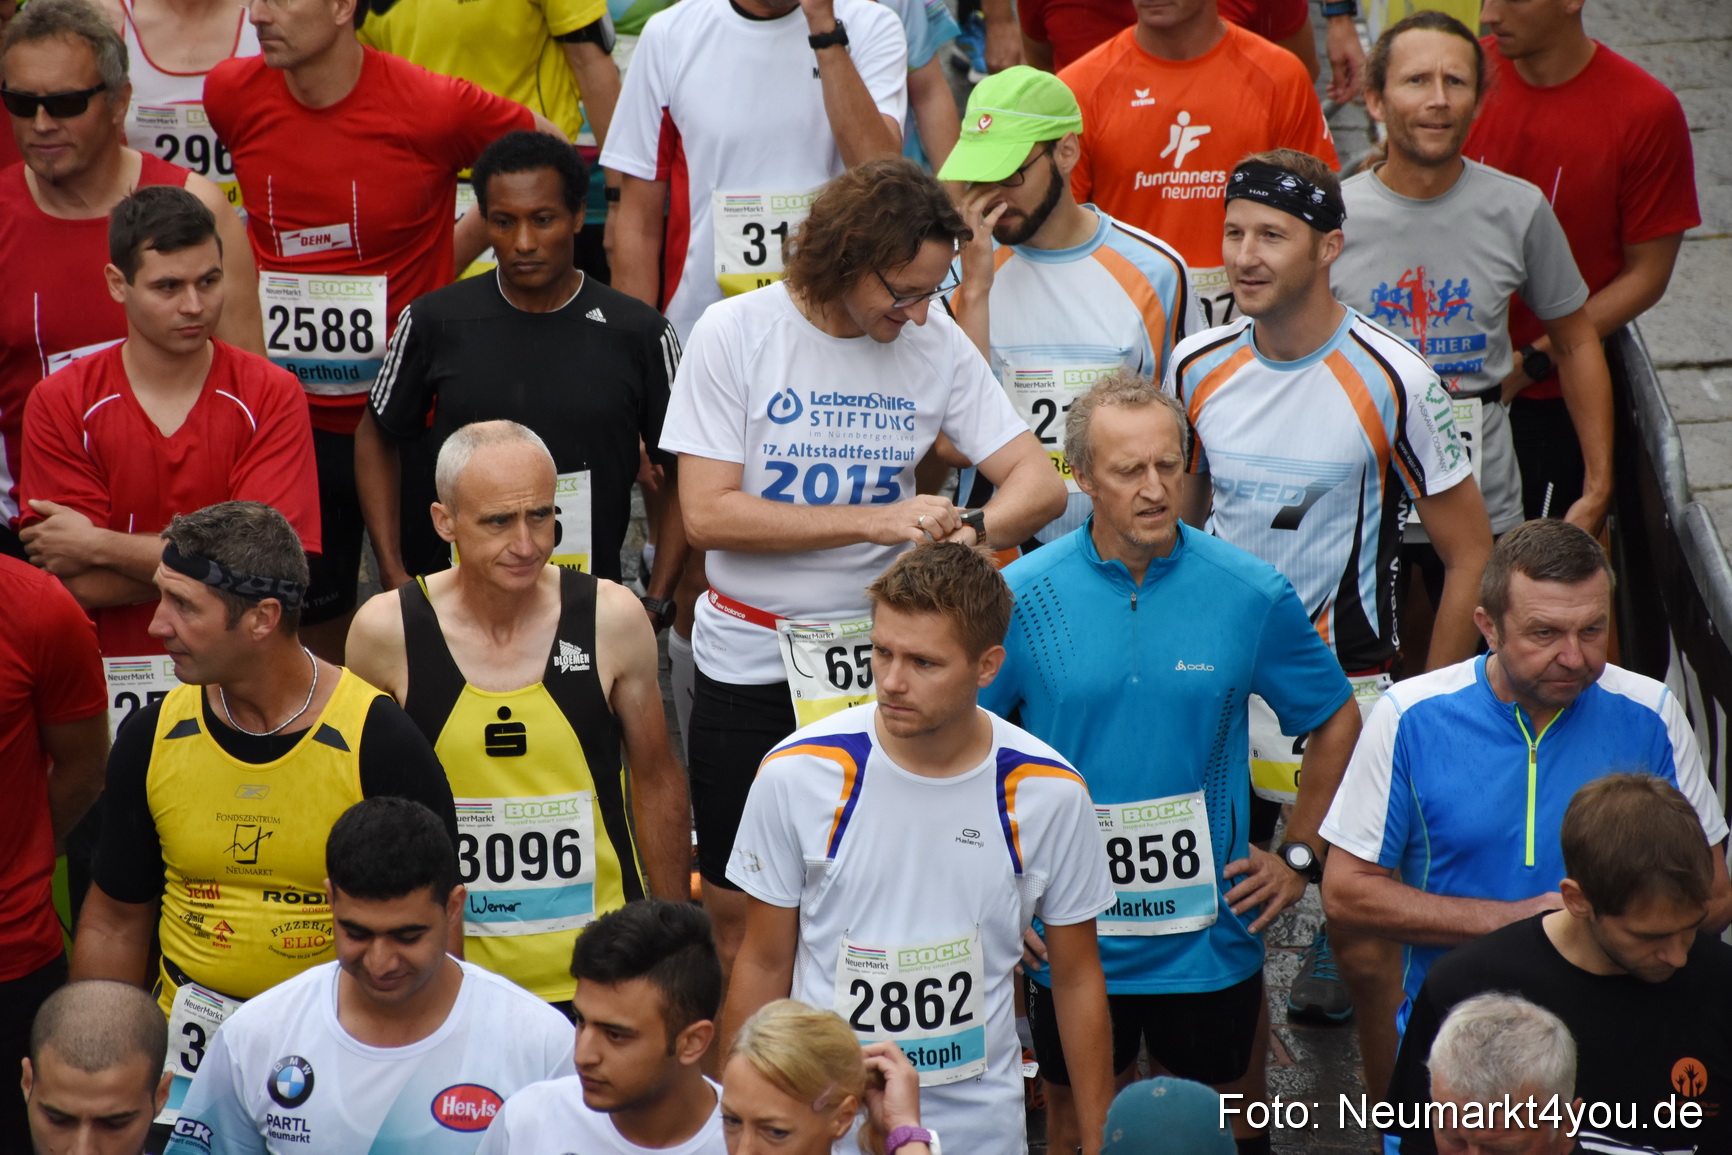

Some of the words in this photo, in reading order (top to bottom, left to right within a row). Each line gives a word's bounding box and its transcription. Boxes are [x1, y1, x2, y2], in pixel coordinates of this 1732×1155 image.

[1135, 170, 1226, 190] funrunners
[771, 191, 822, 210] BOC
[1249, 188, 1268, 197] HAD
[301, 233, 332, 247] DEHN
[308, 280, 375, 297] BOCK
[267, 305, 374, 354] 2588
[1411, 338, 1472, 353] ISHER
[286, 363, 360, 381] Berthold
[1430, 358, 1485, 374] SPORT
[1014, 381, 1056, 389] NeuerMarkt
[810, 410, 915, 432] STIFTUNG
[1031, 398, 1077, 445] 2
[1425, 381, 1461, 470] VIPA
[828, 431, 893, 442] Nürnberger
[763, 443, 782, 457] 17.
[787, 443, 915, 462] Altstadtfestlauf
[761, 461, 905, 506] 2015
[1214, 477, 1306, 507] PEED
[723, 605, 746, 619] balance
[553, 653, 590, 667] BLOEMEN
[1187, 663, 1214, 672] odlo
[107, 672, 154, 681] NeuerMarkt
[114, 691, 170, 739] 2
[455, 814, 496, 823] uerMarkt
[504, 797, 579, 819] BOCK
[1122, 798, 1194, 824] BOCK
[955, 836, 985, 848] Kalenji
[458, 828, 582, 884] 3096
[1106, 829, 1201, 885] 858
[184, 882, 221, 900] Seidl
[1105, 898, 1176, 917] Markus
[270, 920, 334, 938] PIZZERIA
[282, 935, 326, 949] ELIO
[845, 957, 889, 970] NeuerMarkt
[898, 939, 971, 967] BOCK
[183, 998, 223, 1021] NeuerMarkt
[849, 970, 974, 1033] 2862
[901, 1041, 961, 1069] stoph
[273, 1056, 312, 1076] BMW
[441, 1096, 497, 1120] Hervis
[266, 1113, 311, 1133] PARTL
[169, 1136, 185, 1144] mart
[173, 1117, 213, 1150] CK
[267, 1127, 310, 1144] Neumarkt
